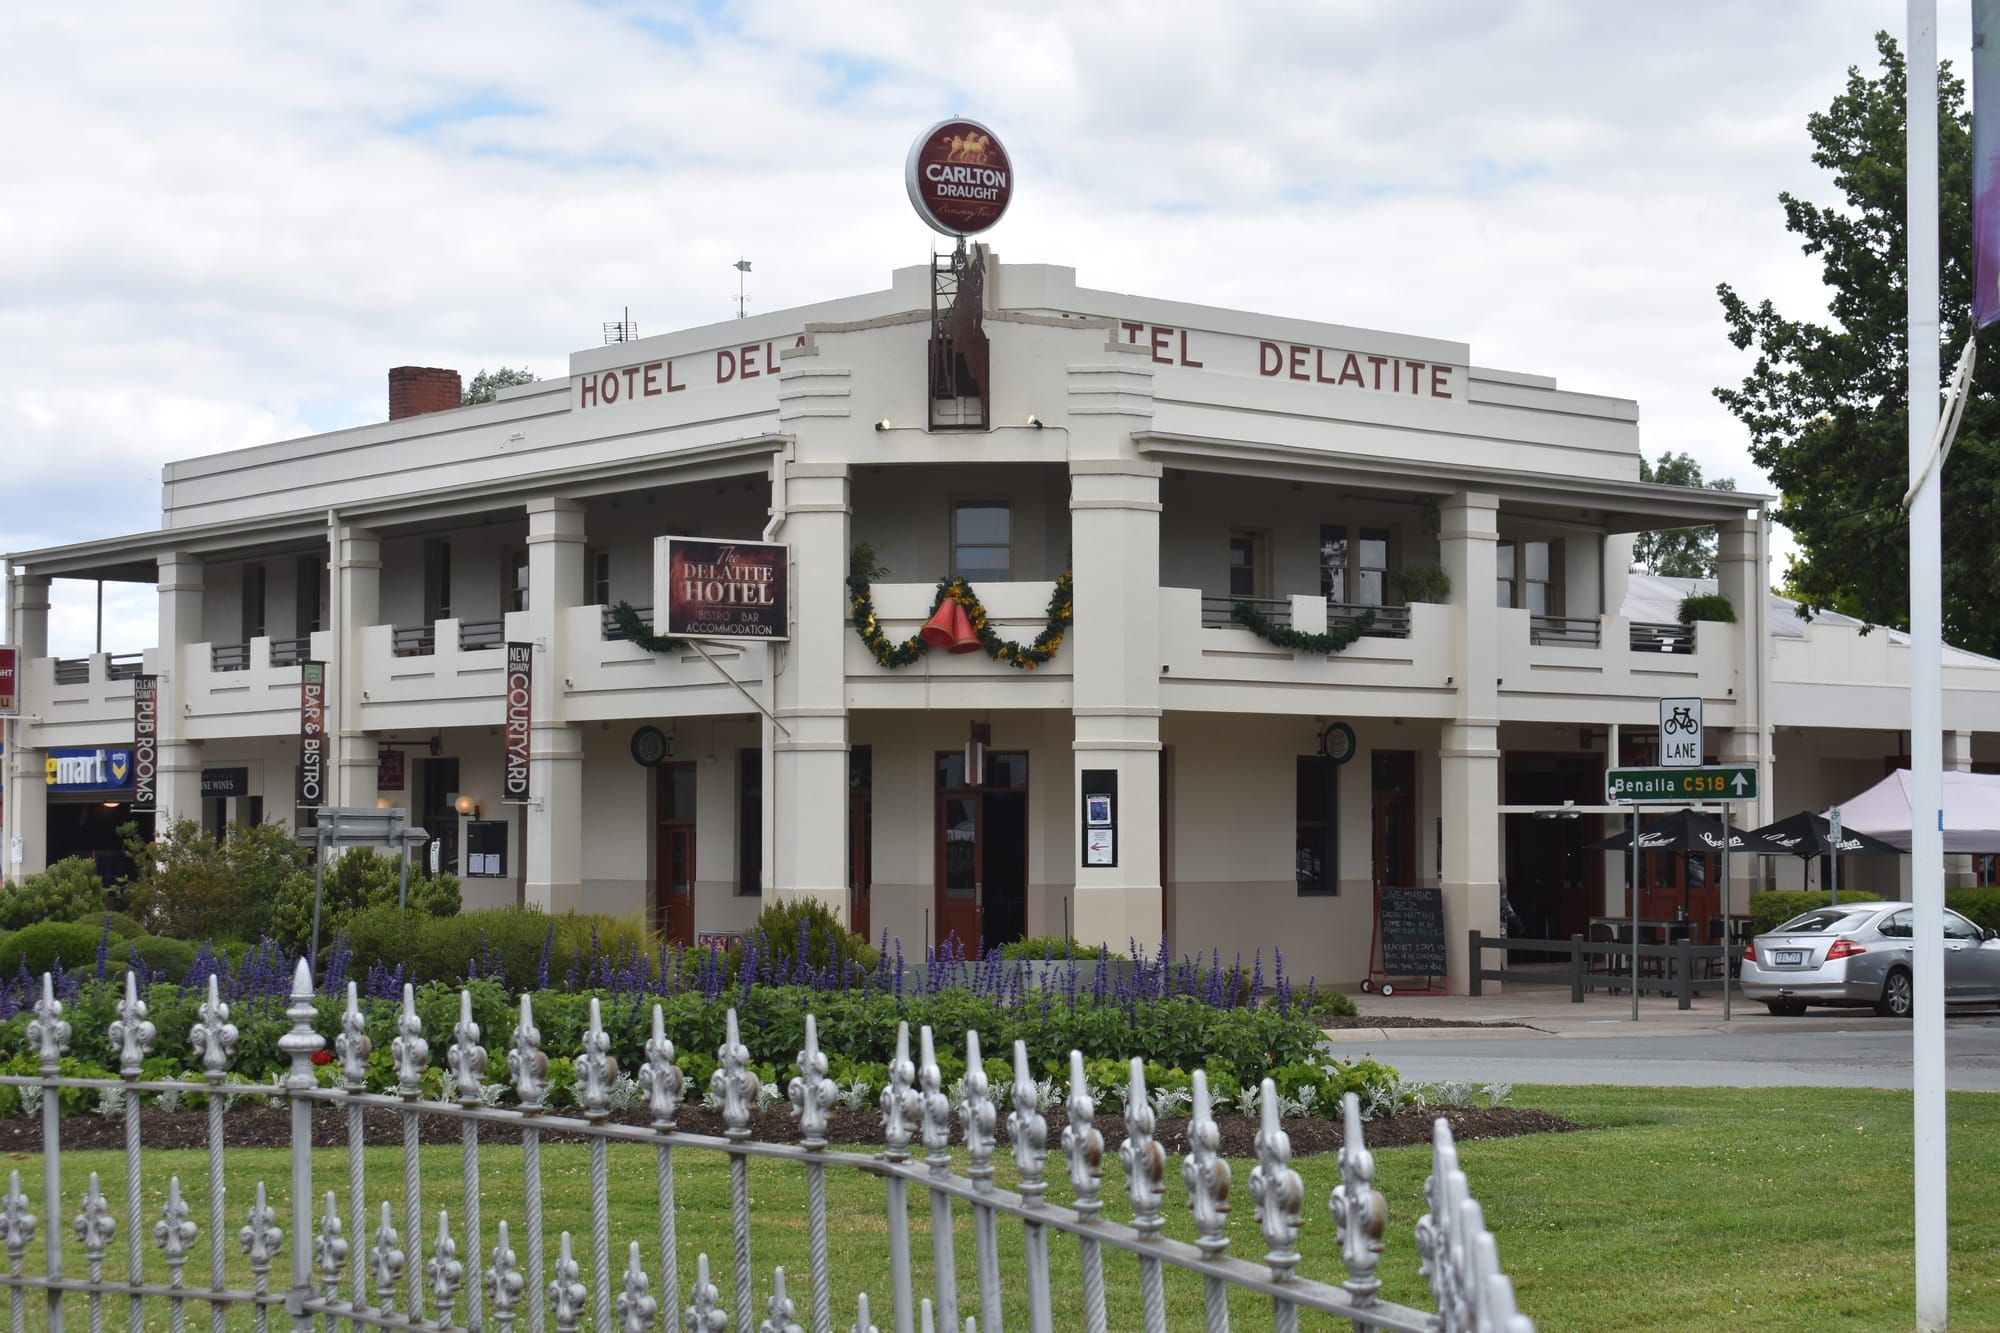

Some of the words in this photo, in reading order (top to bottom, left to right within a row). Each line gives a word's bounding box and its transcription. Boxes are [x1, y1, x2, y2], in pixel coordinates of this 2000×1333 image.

[926, 163, 1006, 188] CARLTON
[937, 184, 998, 201] DRAUGHT
[1259, 340, 1453, 400] DELATITE
[581, 360, 686, 409] HOTEL
[716, 545, 741, 565] The
[684, 563, 774, 582] DELATITE
[684, 581, 775, 605] HOTEL
[697, 610, 730, 621] BISTRO
[741, 611, 759, 623] BAR
[686, 623, 773, 635] ACCOMMODATION
[510, 647, 530, 662] NEW
[510, 663, 530, 673] SHADY
[135, 680, 157, 690] CLEAN
[135, 690, 156, 700] COMFY
[304, 685, 321, 718] BAR
[137, 701, 154, 733] PUB
[304, 722, 320, 735] &
[508, 673, 529, 793] COURTYARD
[112, 752, 127, 763] entry
[1666, 742, 1696, 759] LANE
[136, 738, 154, 802] ROOMS
[304, 739, 320, 799] BISTRO
[212, 779, 234, 790] WINES
[1615, 778, 1675, 793] Benalla
[1683, 777, 1725, 792] C518
[1831, 811, 1840, 820] 2P
[1404, 889, 1433, 901] MUSIC
